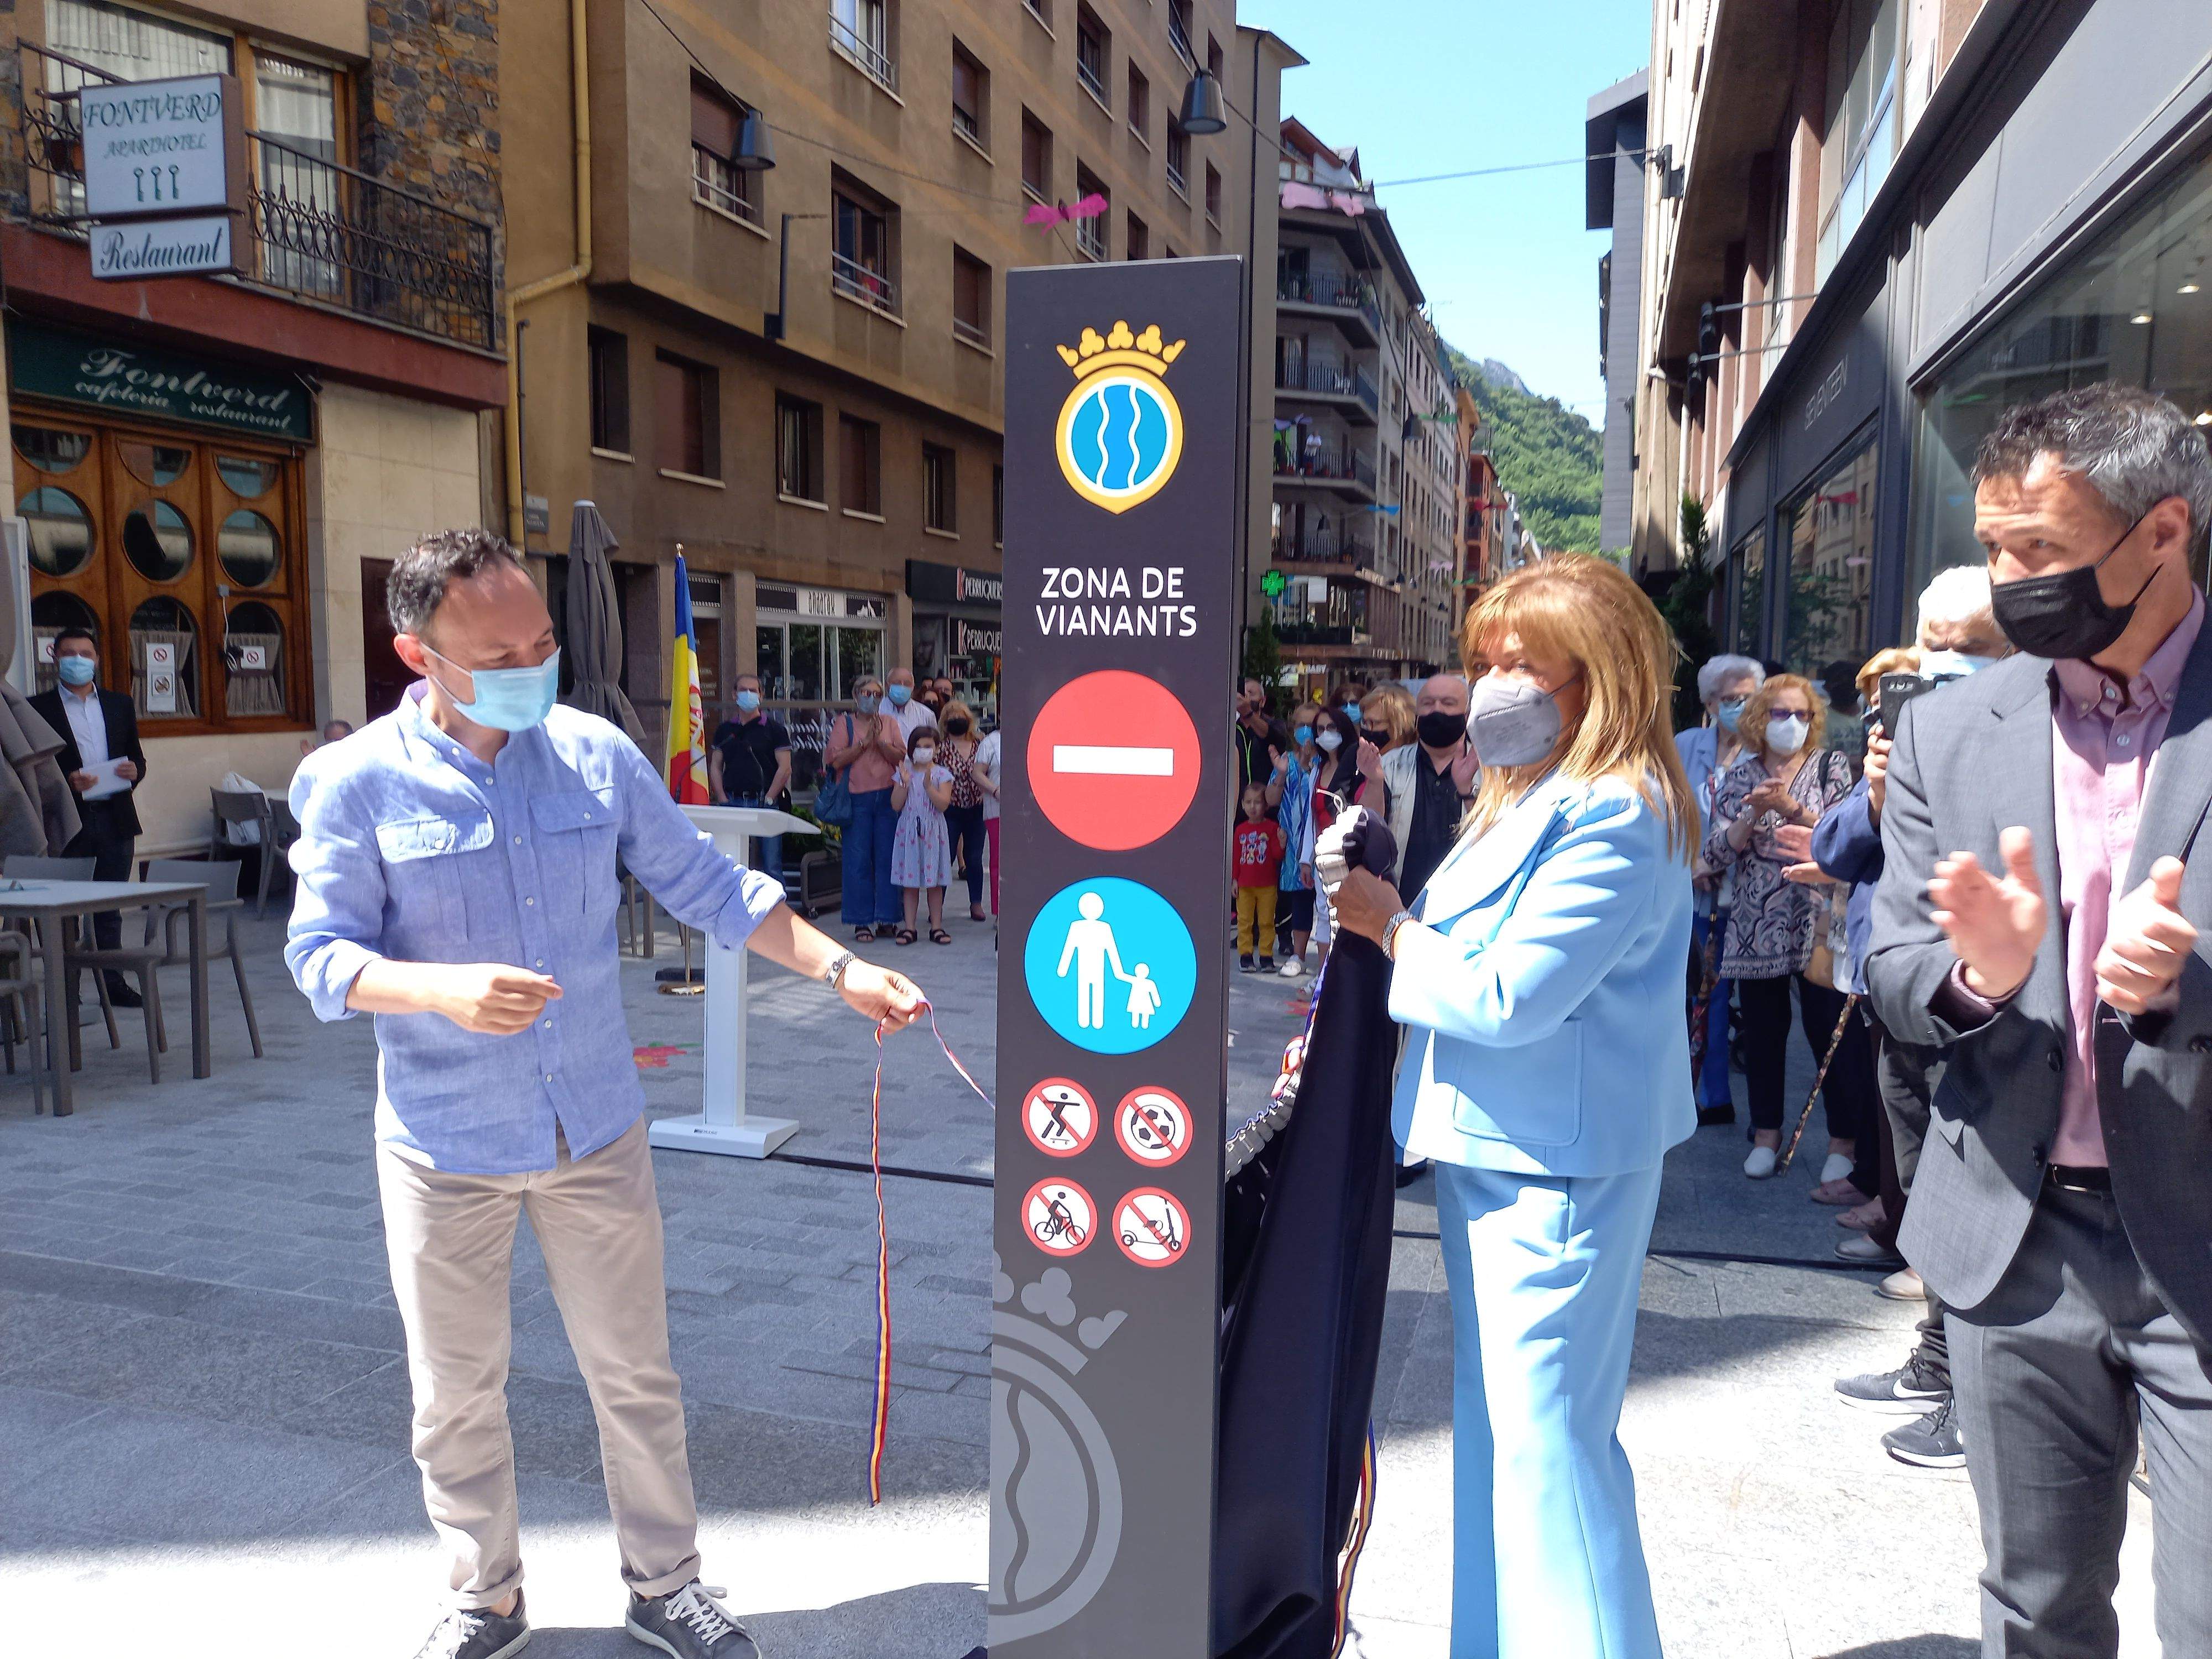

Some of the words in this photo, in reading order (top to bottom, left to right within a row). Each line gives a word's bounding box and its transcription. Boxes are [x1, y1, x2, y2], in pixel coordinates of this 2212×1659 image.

[84, 92, 222, 128] FONTVERD
[103, 133, 208, 158] APARTHOTEL
[100, 226, 223, 272] Restaurant
[80, 348, 290, 411] Fontverd
[1041, 567, 1131, 599] ZONA
[1142, 567, 1185, 599] DE
[1035, 604, 1197, 637] VIANANTS
